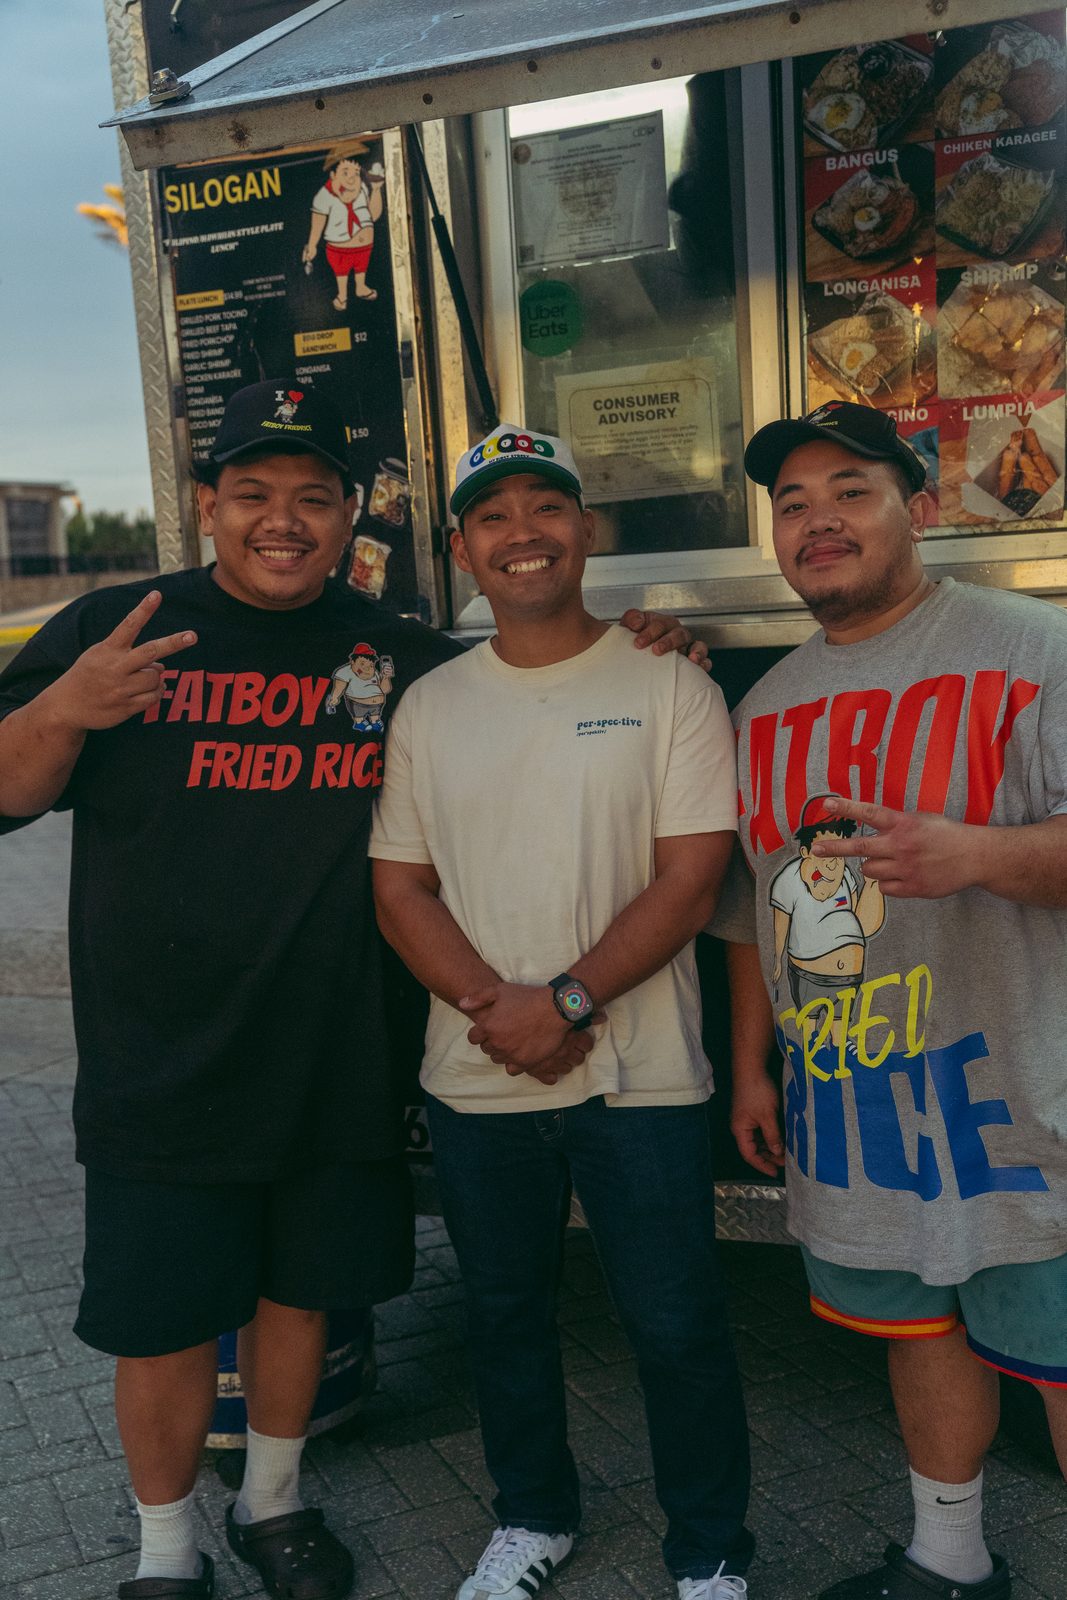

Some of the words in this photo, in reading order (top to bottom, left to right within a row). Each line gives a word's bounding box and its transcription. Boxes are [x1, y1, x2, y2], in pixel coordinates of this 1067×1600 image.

[943, 138, 992, 155] CHIKEN
[996, 129, 1057, 148] KARAGEE
[825, 149, 899, 171] BANGUS
[164, 167, 282, 213] SILOGAN
[823, 274, 922, 296] LONGANISA
[960, 264, 1039, 287] SHRIMP
[222, 309, 248, 319] TOCINO
[527, 304, 567, 320] Uber
[354, 332, 367, 343] $12
[528, 322, 568, 338] Eats
[275, 390, 285, 401] I
[593, 392, 680, 411] CONSUMER
[598, 407, 677, 426] ADVISORY
[962, 401, 1037, 421] LUMPIA
[143, 669, 330, 728] FATBOY
[186, 740, 302, 791] FRIED
[735, 669, 1041, 856] ATBOY
